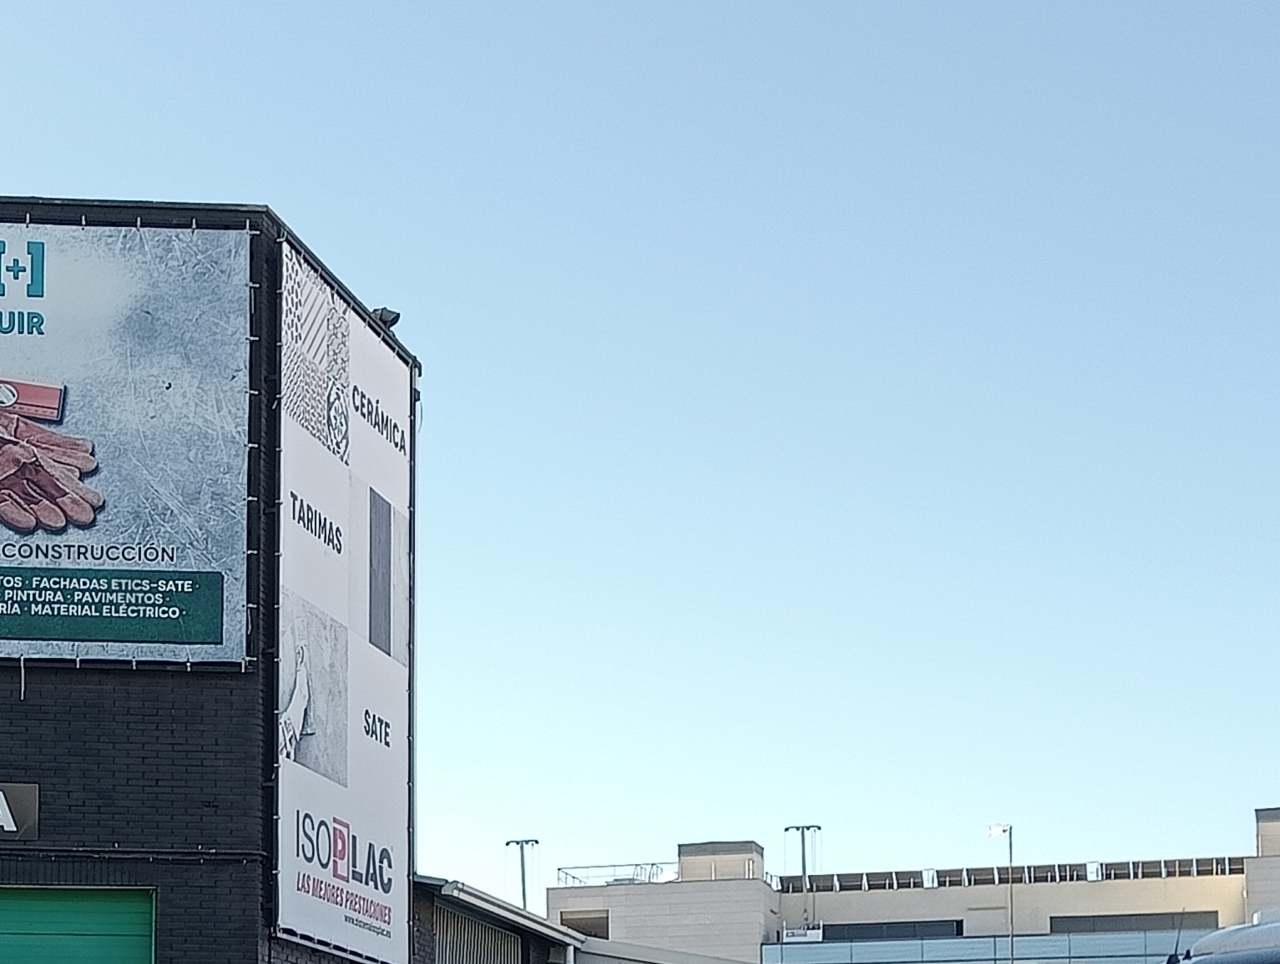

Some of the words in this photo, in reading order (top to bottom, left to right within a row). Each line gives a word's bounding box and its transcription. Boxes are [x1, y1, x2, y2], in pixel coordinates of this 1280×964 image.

[352, 385, 407, 456] CERÁMICA
[290, 491, 342, 554] TARIMAS
[1, 543, 177, 563] CONSTRUCCIÓN
[4, 591, 64, 602] PINTURA
[74, 592, 163, 604] PAVIMENTOS
[32, 577, 108, 590] FACHADAS
[31, 604, 100, 616] MATERIAL
[102, 604, 180, 618] ELÉCTRICO
[364, 709, 391, 748] SATE
[296, 809, 393, 894] ISOPLAC
[297, 872, 310, 894] LAS
[312, 877, 344, 907] MEJORES
[345, 890, 391, 925] PRESTACIONES
